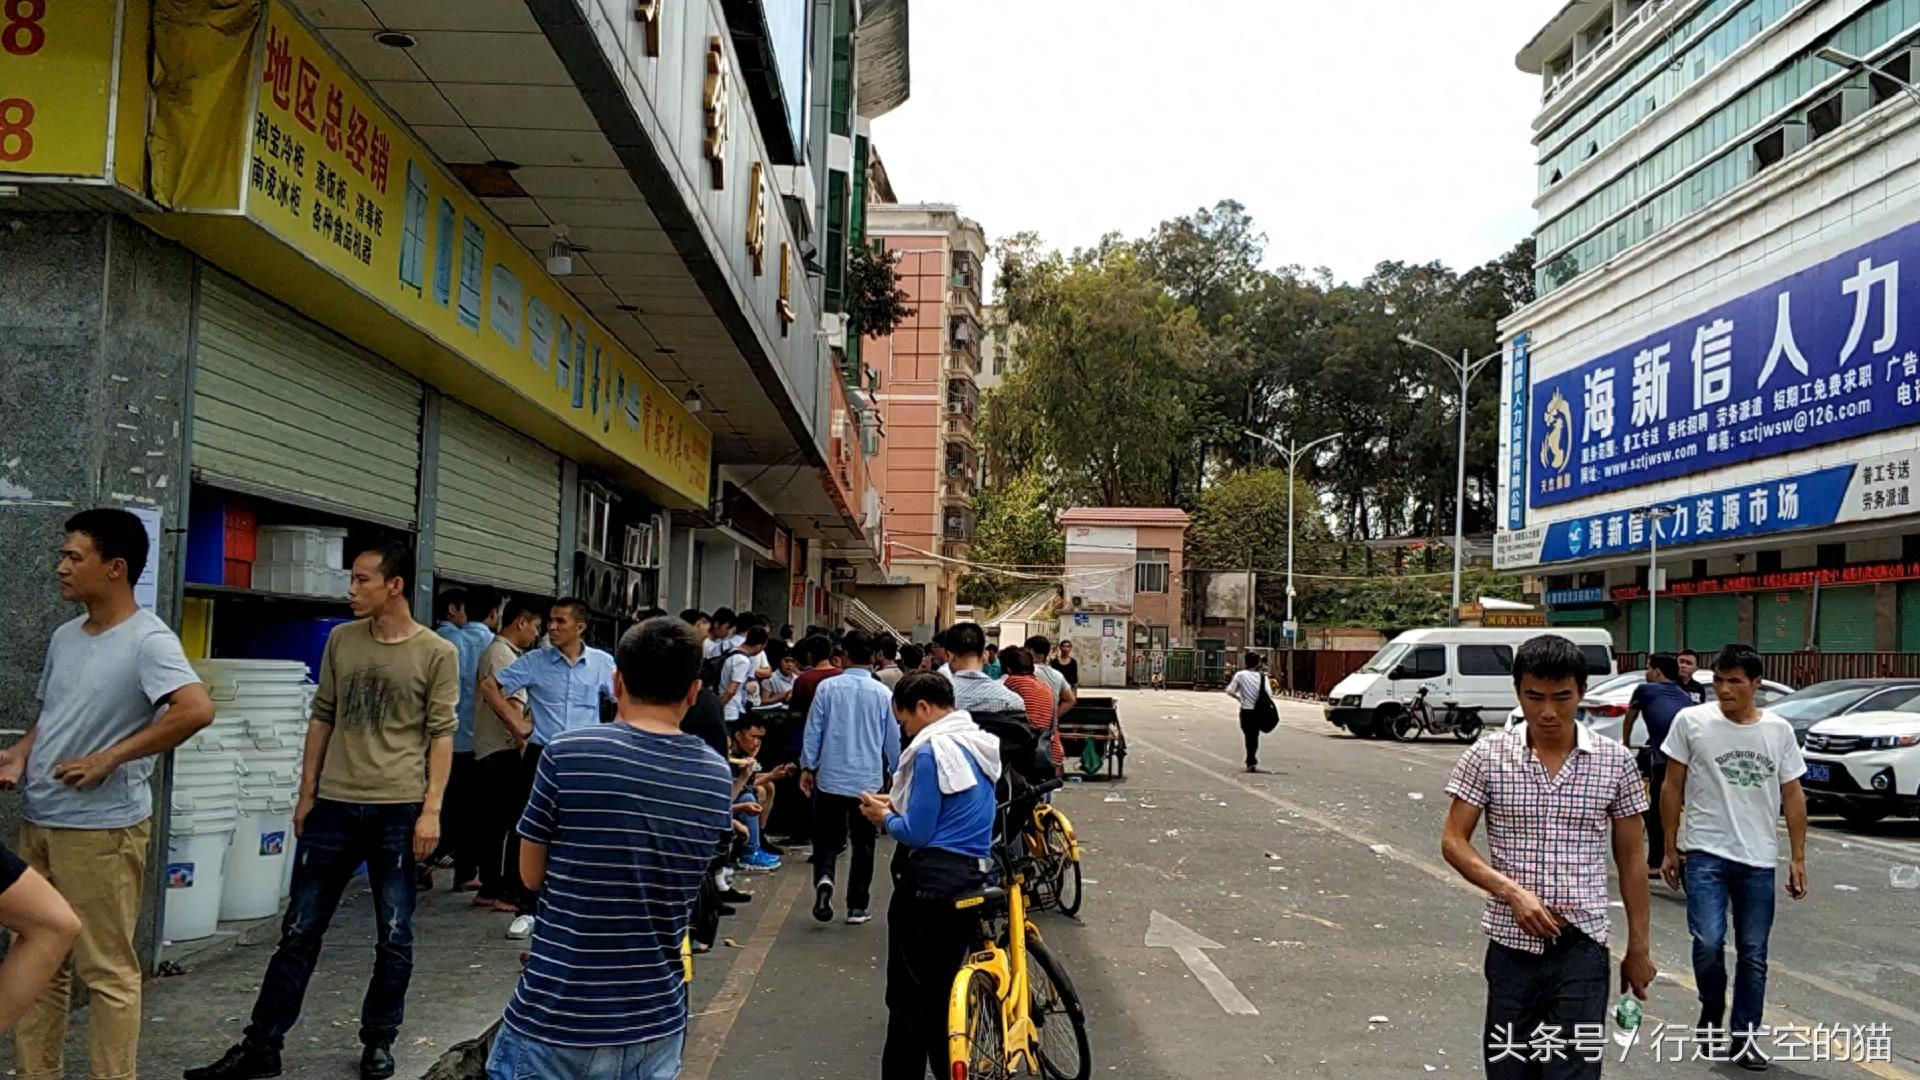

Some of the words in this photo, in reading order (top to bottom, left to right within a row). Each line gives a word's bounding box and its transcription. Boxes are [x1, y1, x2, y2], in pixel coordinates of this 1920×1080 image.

[254, 111, 305, 179] 科宝冷柜
[262, 25, 391, 196] 地区总经销
[312, 198, 373, 267] 各种食品机器
[1582, 256, 1901, 444] 海新信人力
[1604, 443, 1698, 478] www.sztjwsw.com
[1739, 398, 1873, 444] sztjwsw@126.com
[1897, 379, 1920, 406] 电
[1623, 426, 1660, 454] 普工专送
[1667, 411, 1708, 442] 委托招聘
[1715, 396, 1763, 428] 劳务派遣
[1773, 364, 1873, 412] 短期工免费求职
[1863, 459, 1910, 485] 普工专送
[1863, 486, 1910, 512] 劳务派遣
[1714, 750, 1756, 766] SUPERIOR
